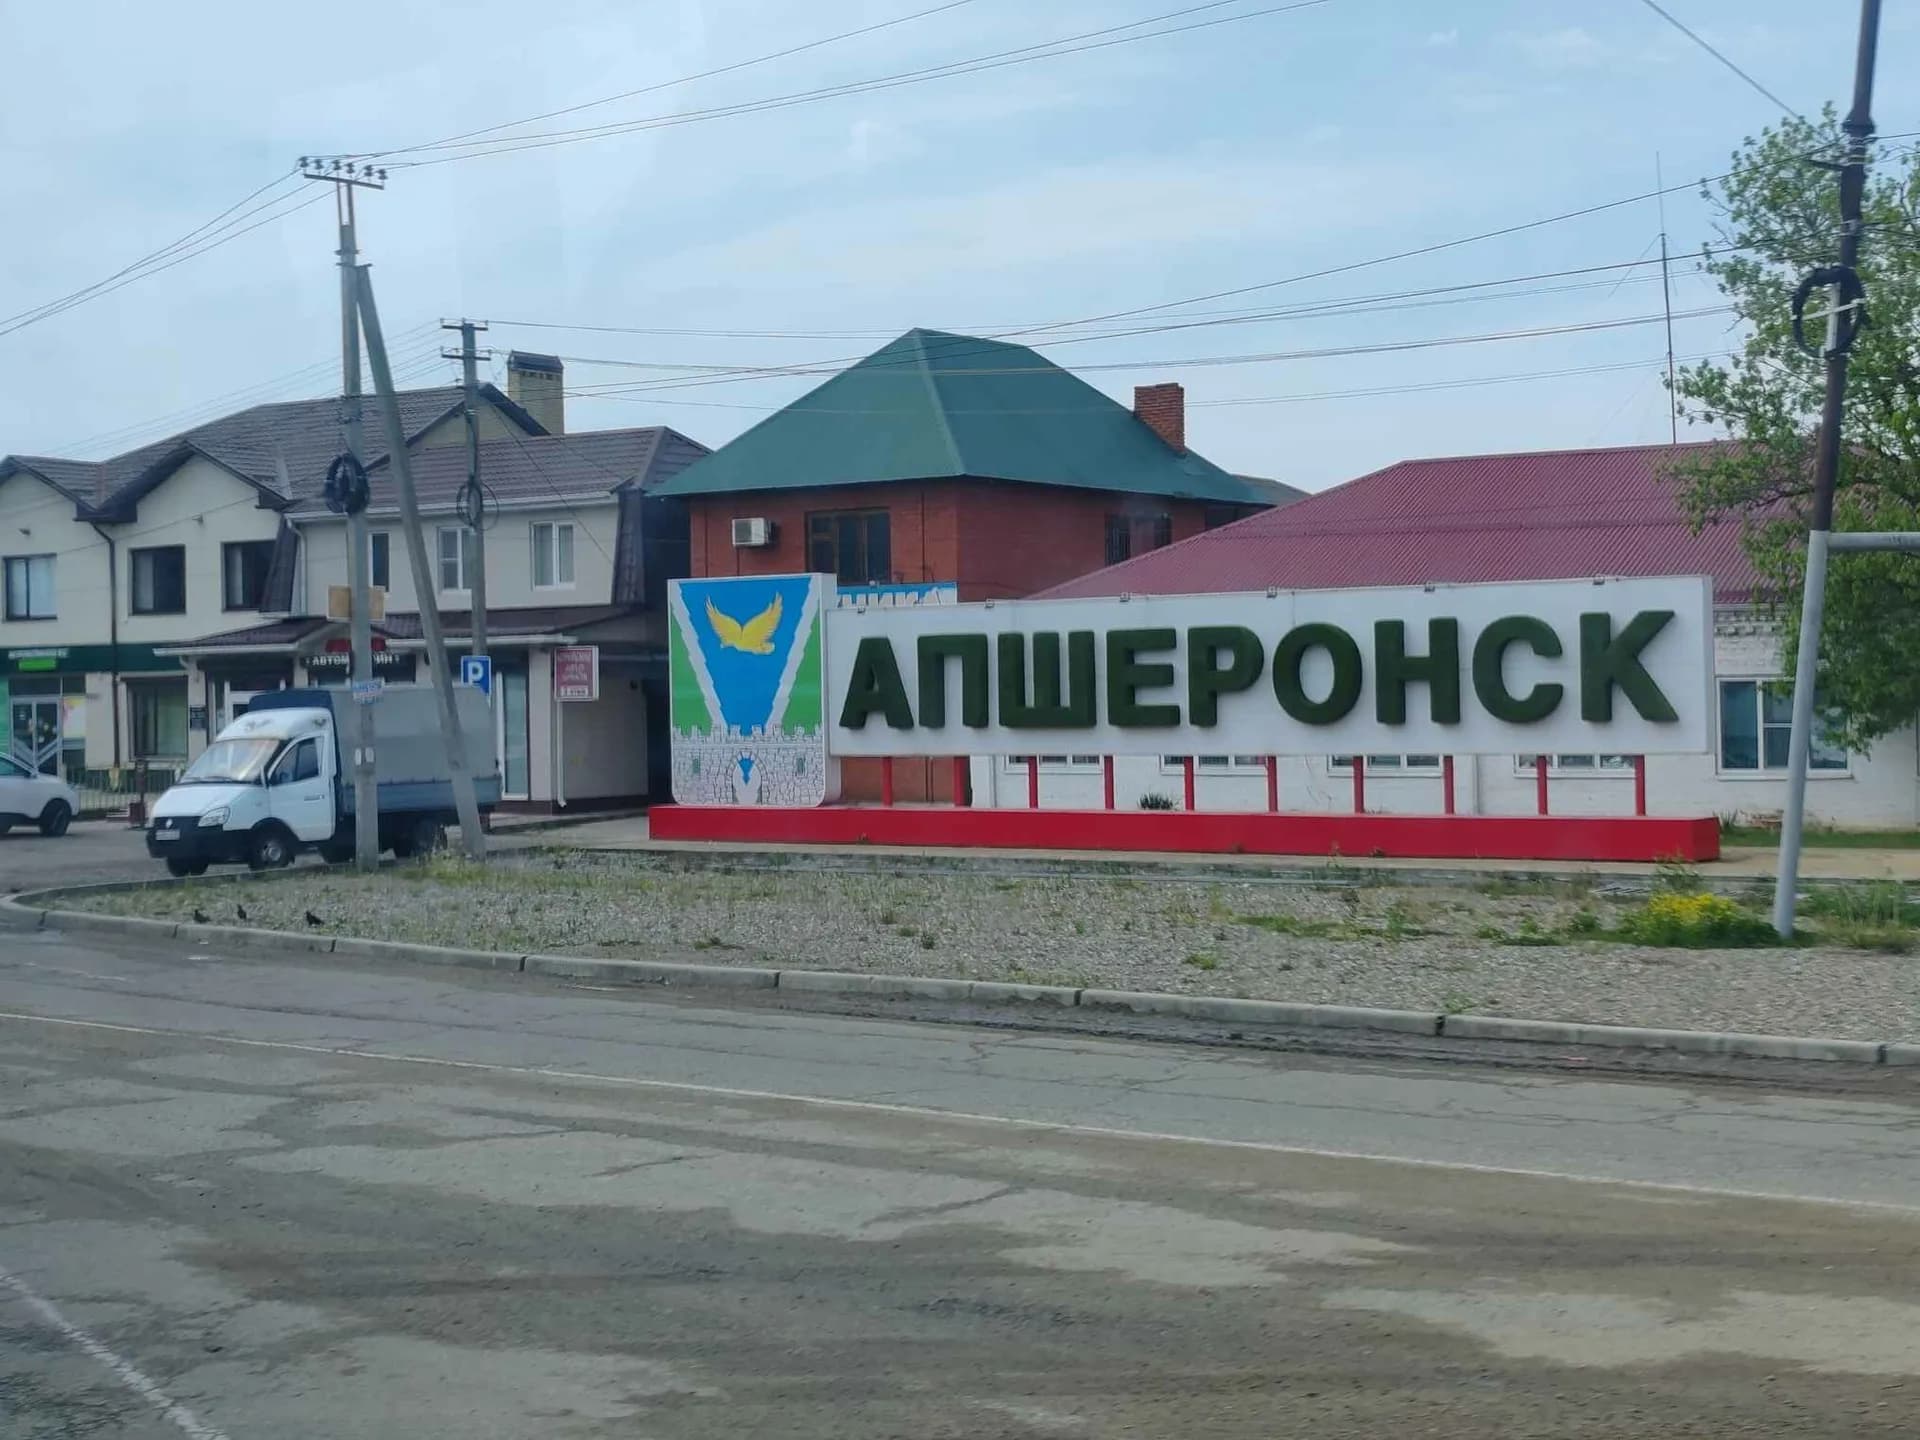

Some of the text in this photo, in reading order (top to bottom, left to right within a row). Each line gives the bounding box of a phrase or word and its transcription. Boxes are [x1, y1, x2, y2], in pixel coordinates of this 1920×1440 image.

[312, 653, 393, 666] АВТОМИН
[839, 610, 1679, 729] АПШЕРОНСК
[467, 661, 484, 687] P
